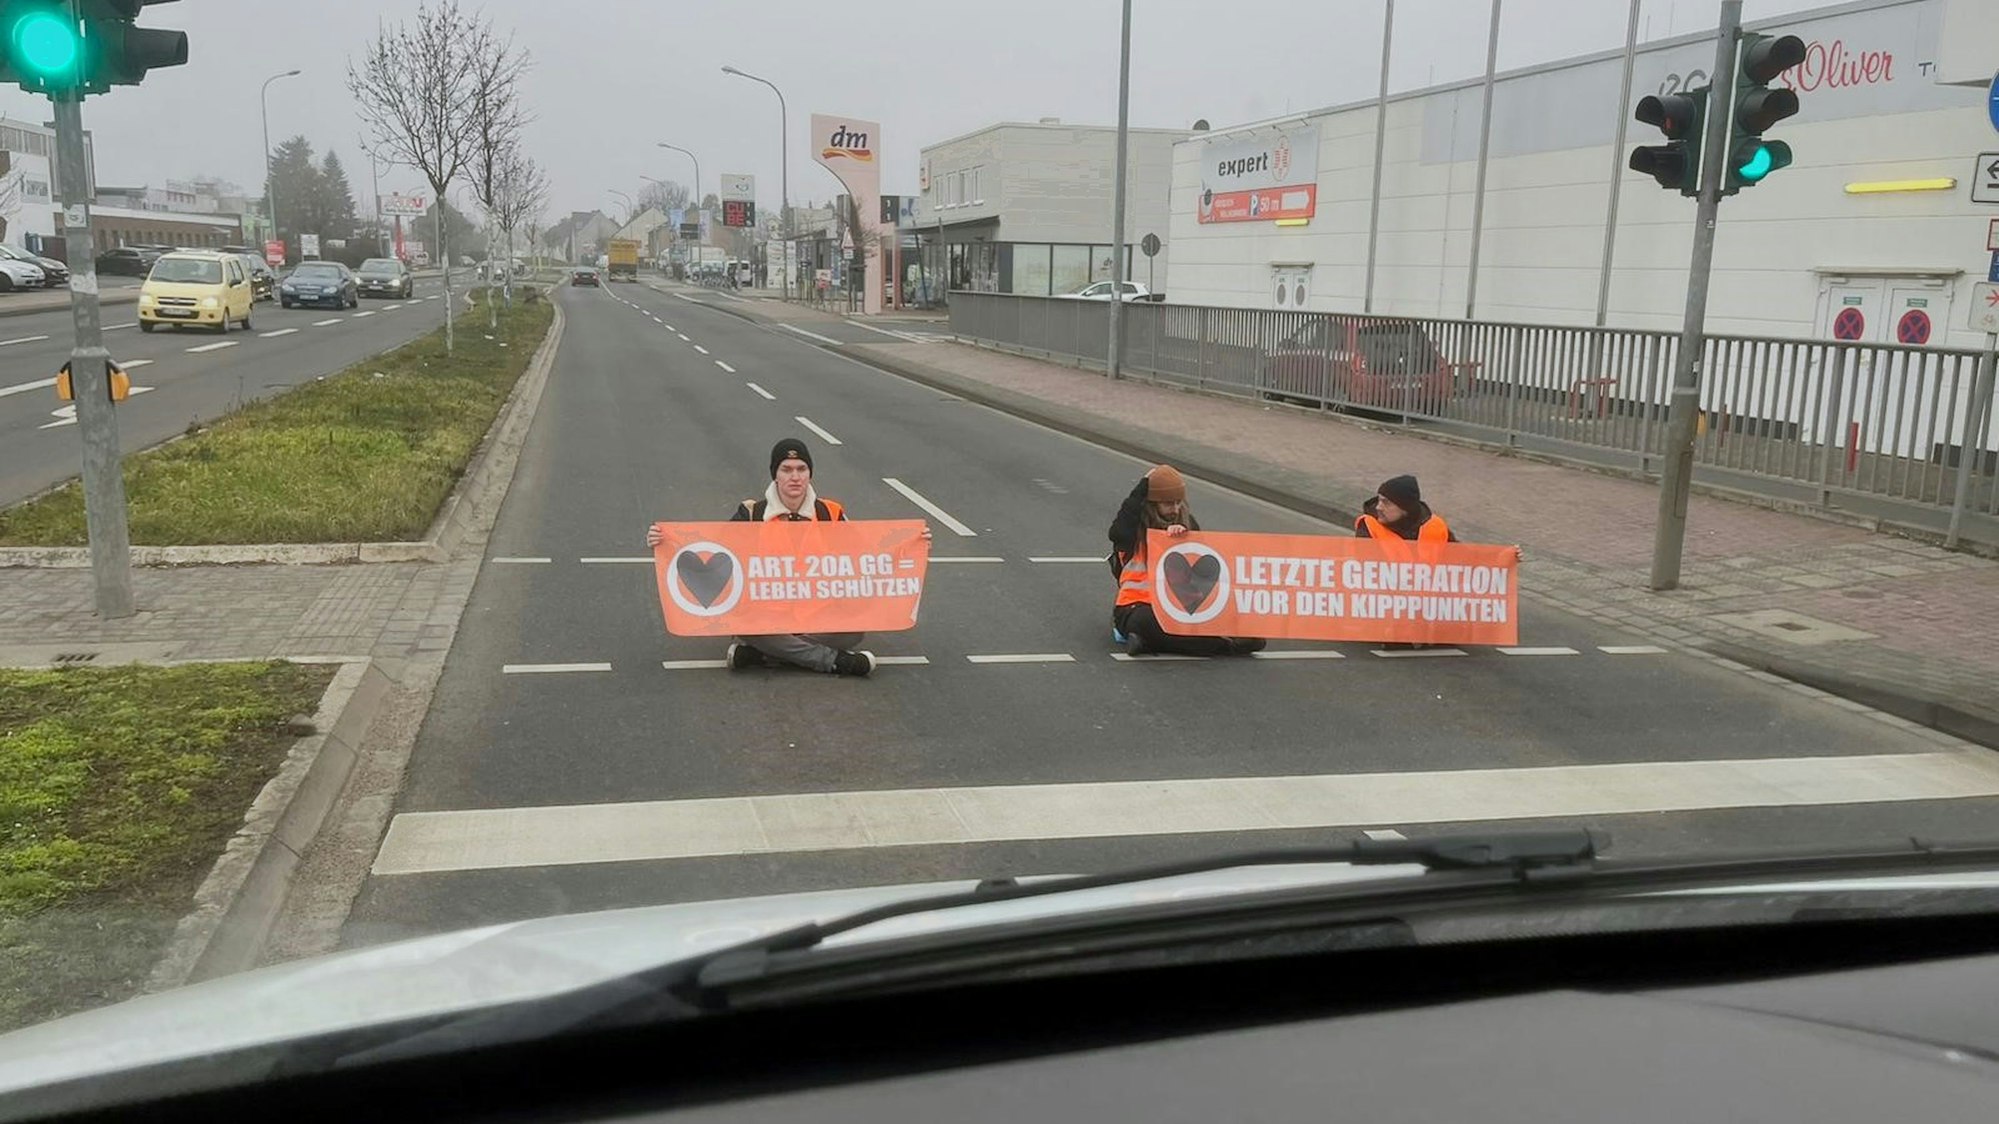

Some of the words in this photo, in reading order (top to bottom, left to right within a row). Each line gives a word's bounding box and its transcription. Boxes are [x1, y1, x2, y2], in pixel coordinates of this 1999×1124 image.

[830, 125, 867, 149] dm
[1218, 151, 1268, 178] expert
[748, 555, 800, 578] ART.
[805, 554, 855, 577] 20A
[859, 553, 893, 576] GG
[1235, 555, 1335, 588] LETZTE
[1342, 560, 1508, 595] GENERATION
[749, 581, 811, 601] LEBEN
[816, 575, 920, 599] SCHÜTZEN
[1234, 589, 1289, 615] VOR
[1296, 591, 1344, 617] DEN
[1351, 593, 1507, 623] KIPPPUNKTEN
